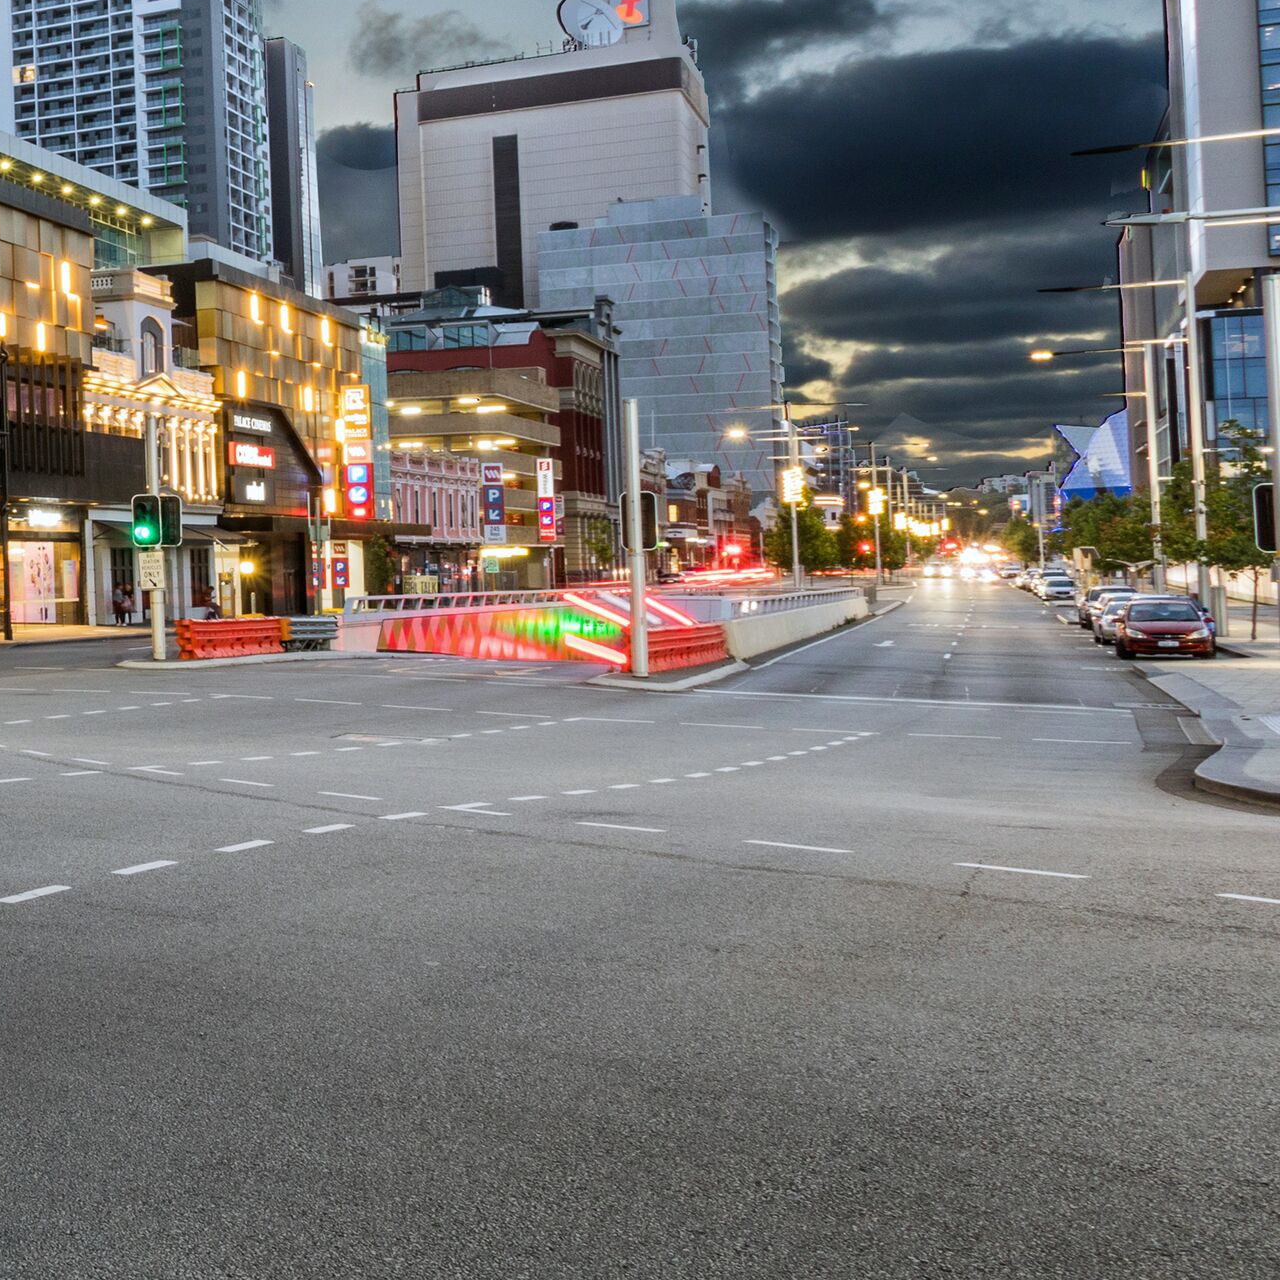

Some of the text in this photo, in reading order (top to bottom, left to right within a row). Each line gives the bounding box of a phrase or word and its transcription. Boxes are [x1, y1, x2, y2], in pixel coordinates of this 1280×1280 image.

[488, 489, 500, 503] P
[542, 502, 552, 511] P
[336, 562, 344, 571] P
[143, 571, 160, 579] ONLY
